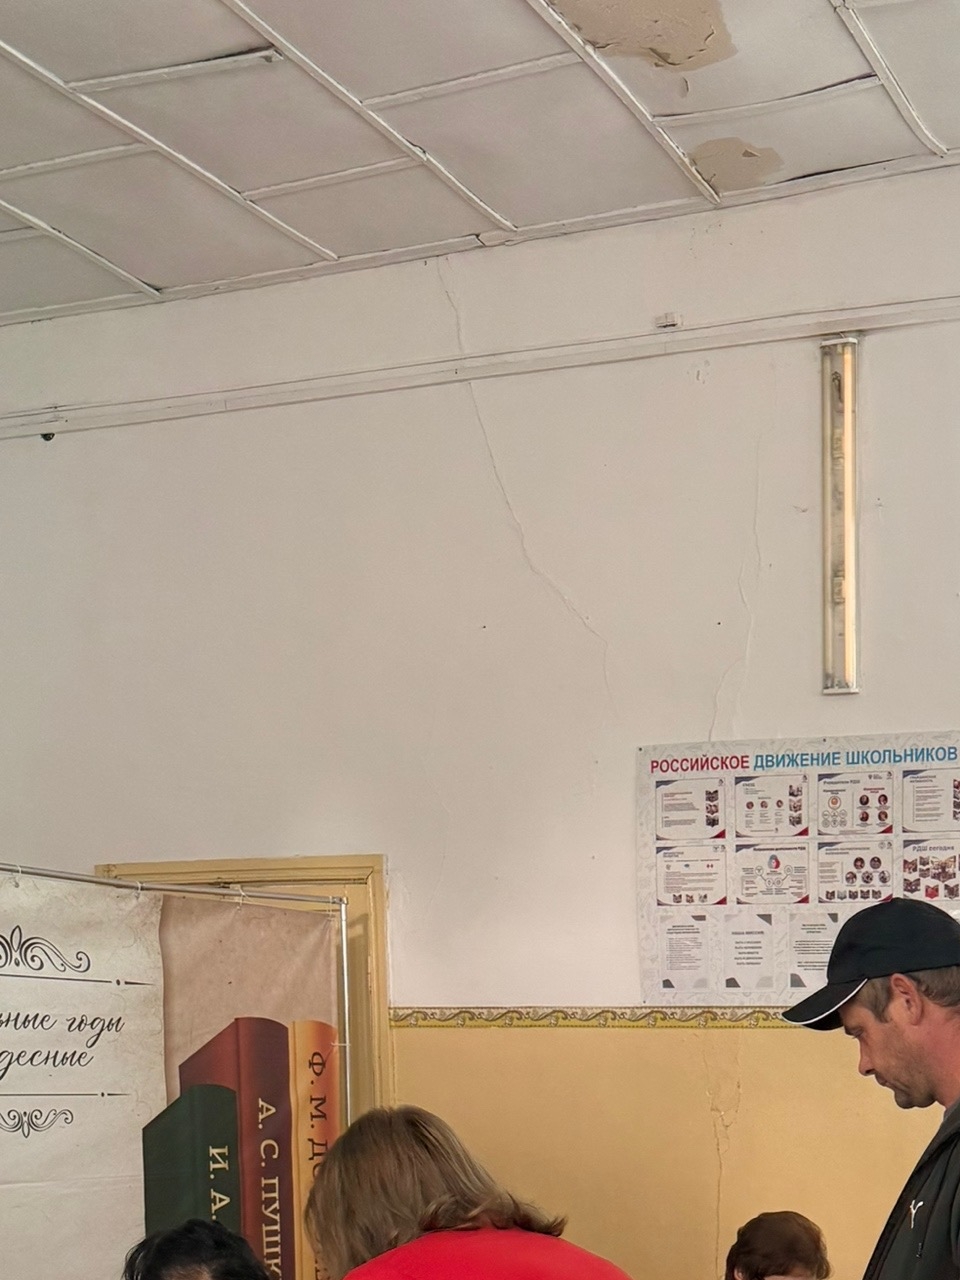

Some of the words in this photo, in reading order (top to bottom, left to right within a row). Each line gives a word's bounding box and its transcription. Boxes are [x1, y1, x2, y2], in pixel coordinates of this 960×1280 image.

[650, 754, 749, 774] РОССИЙСКОЕ
[753, 751, 841, 771] ДВИЖЕНИЕ
[845, 746, 958, 766] ШКОЛЬНИКОВ
[66, 1014, 126, 1048] годы
[308, 1051, 326, 1086] Ф.
[258, 1098, 277, 1130] А.
[309, 1095, 328, 1129] М.
[209, 1145, 229, 1180] И.
[260, 1139, 279, 1168] С.
